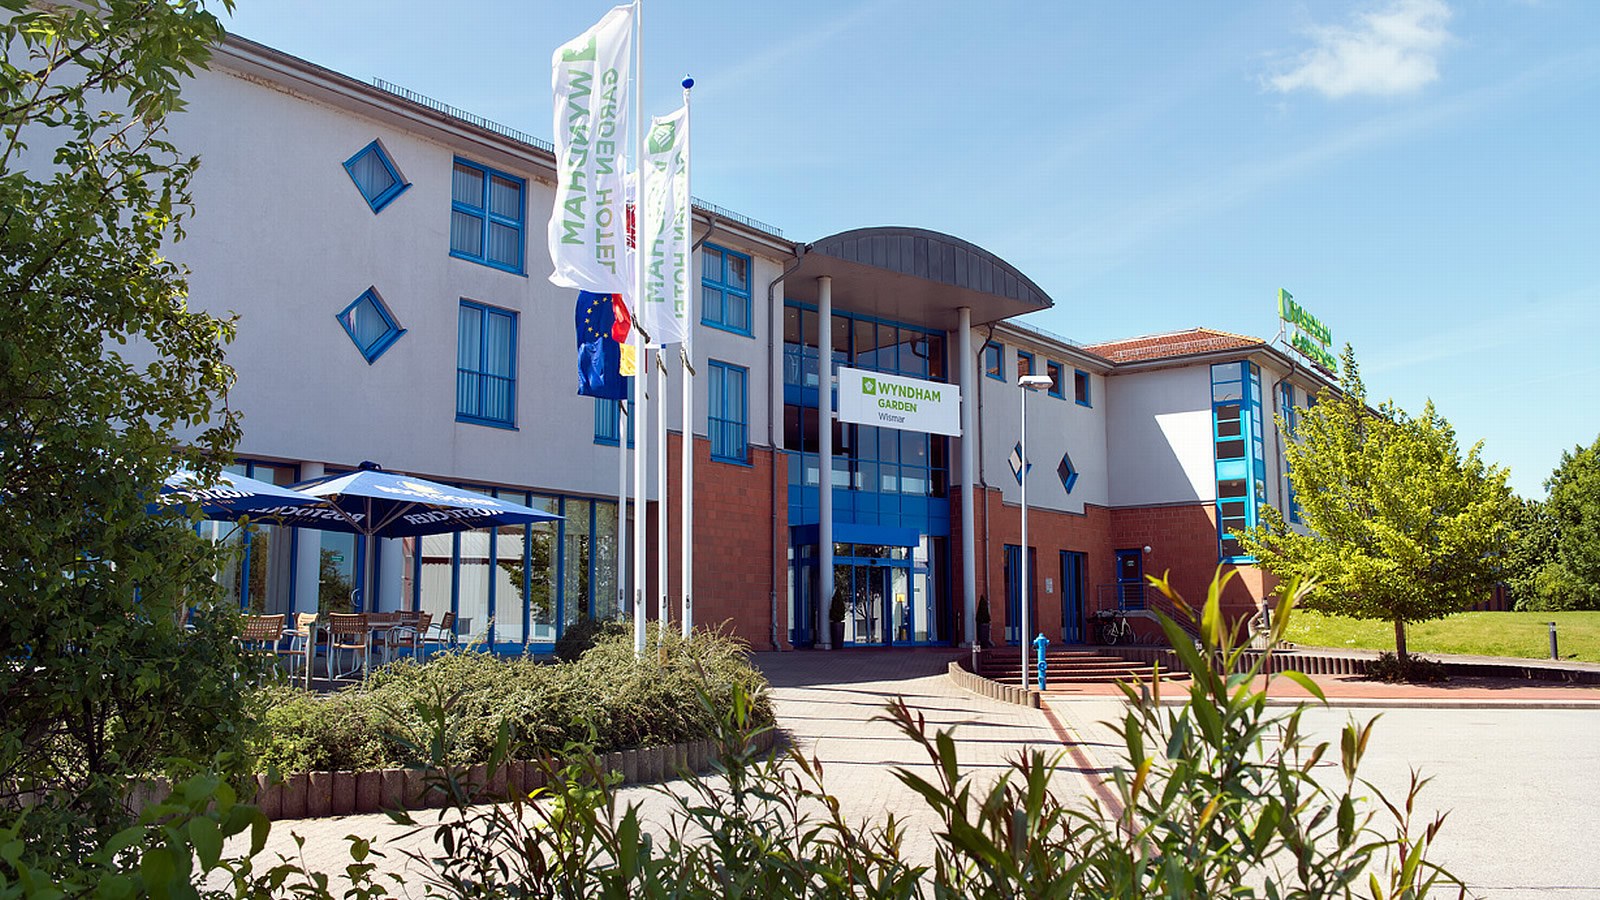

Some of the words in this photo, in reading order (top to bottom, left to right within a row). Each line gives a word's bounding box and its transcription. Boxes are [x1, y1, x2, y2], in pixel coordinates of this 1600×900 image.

[878, 381, 941, 402] WYNDHAM
[878, 398, 917, 412] GARDEN
[878, 412, 905, 423] Wismar
